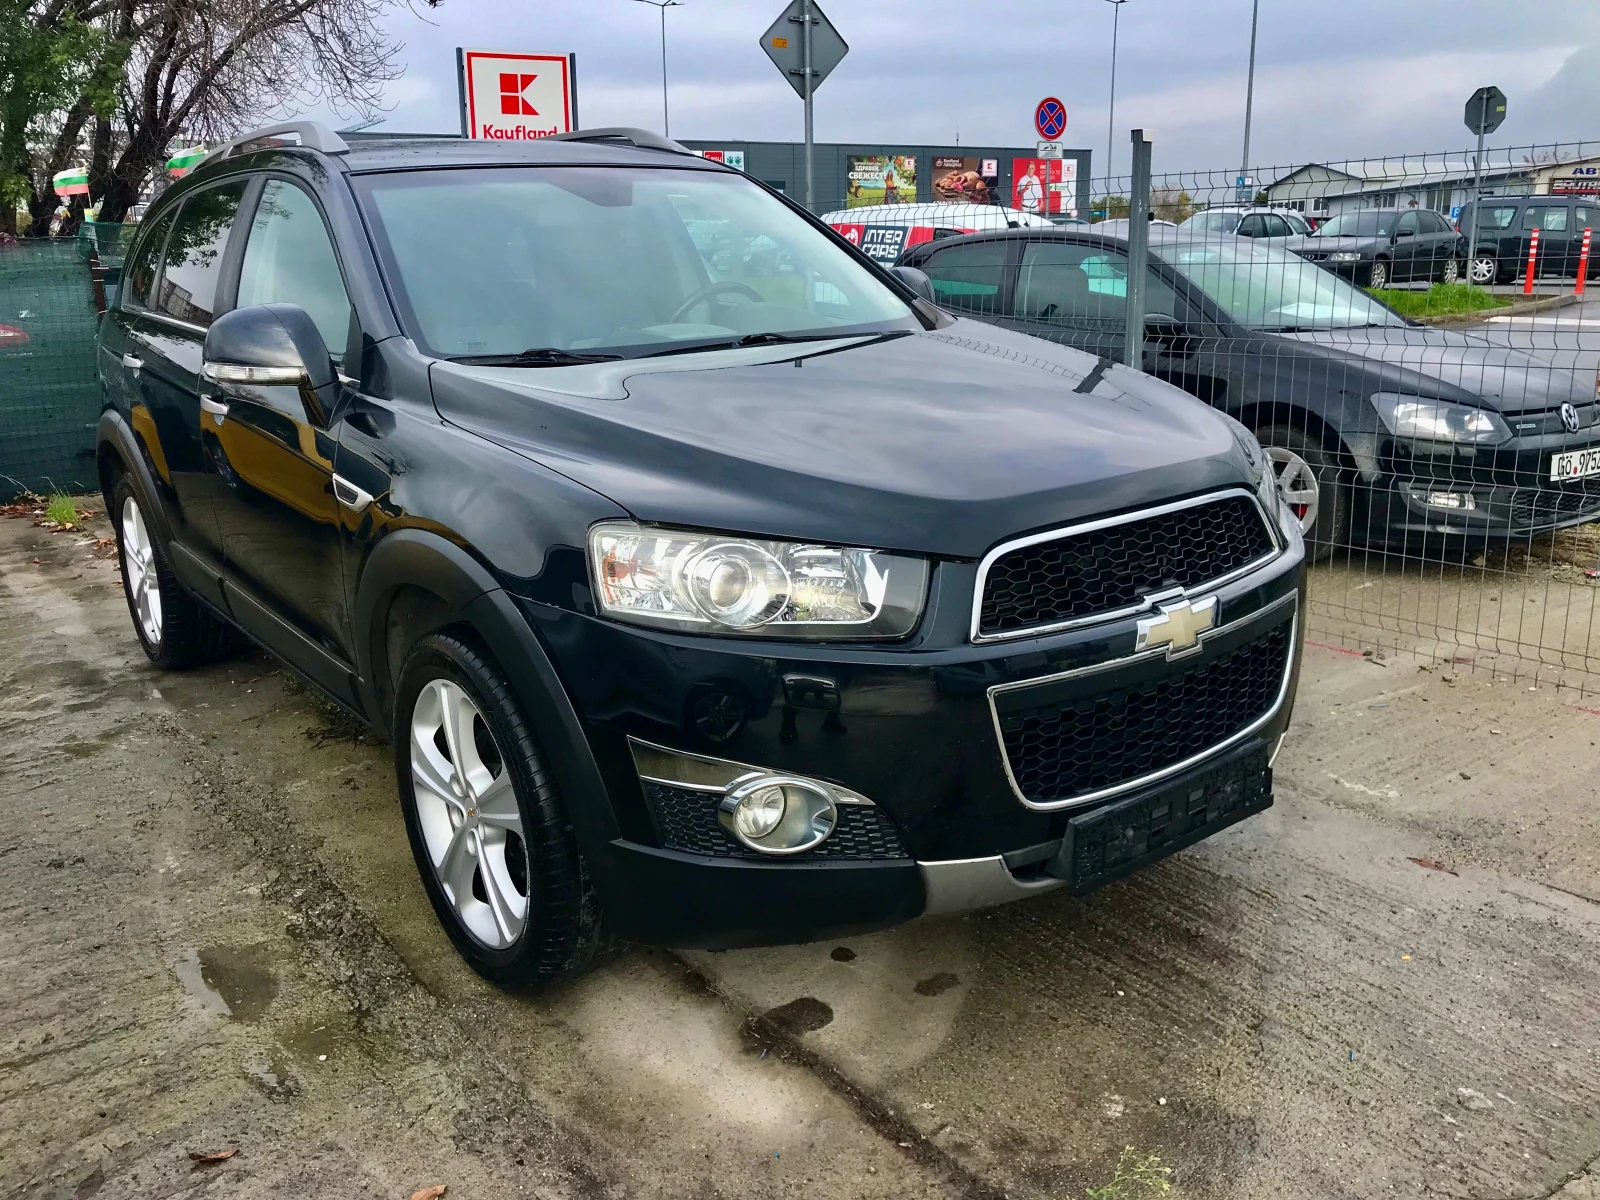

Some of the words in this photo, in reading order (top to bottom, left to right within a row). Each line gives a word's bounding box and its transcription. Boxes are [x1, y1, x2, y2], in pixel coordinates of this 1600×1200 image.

[1572, 167, 1600, 175] АВ
[864, 229, 904, 243] INTER
[862, 243, 899, 259] CARS
